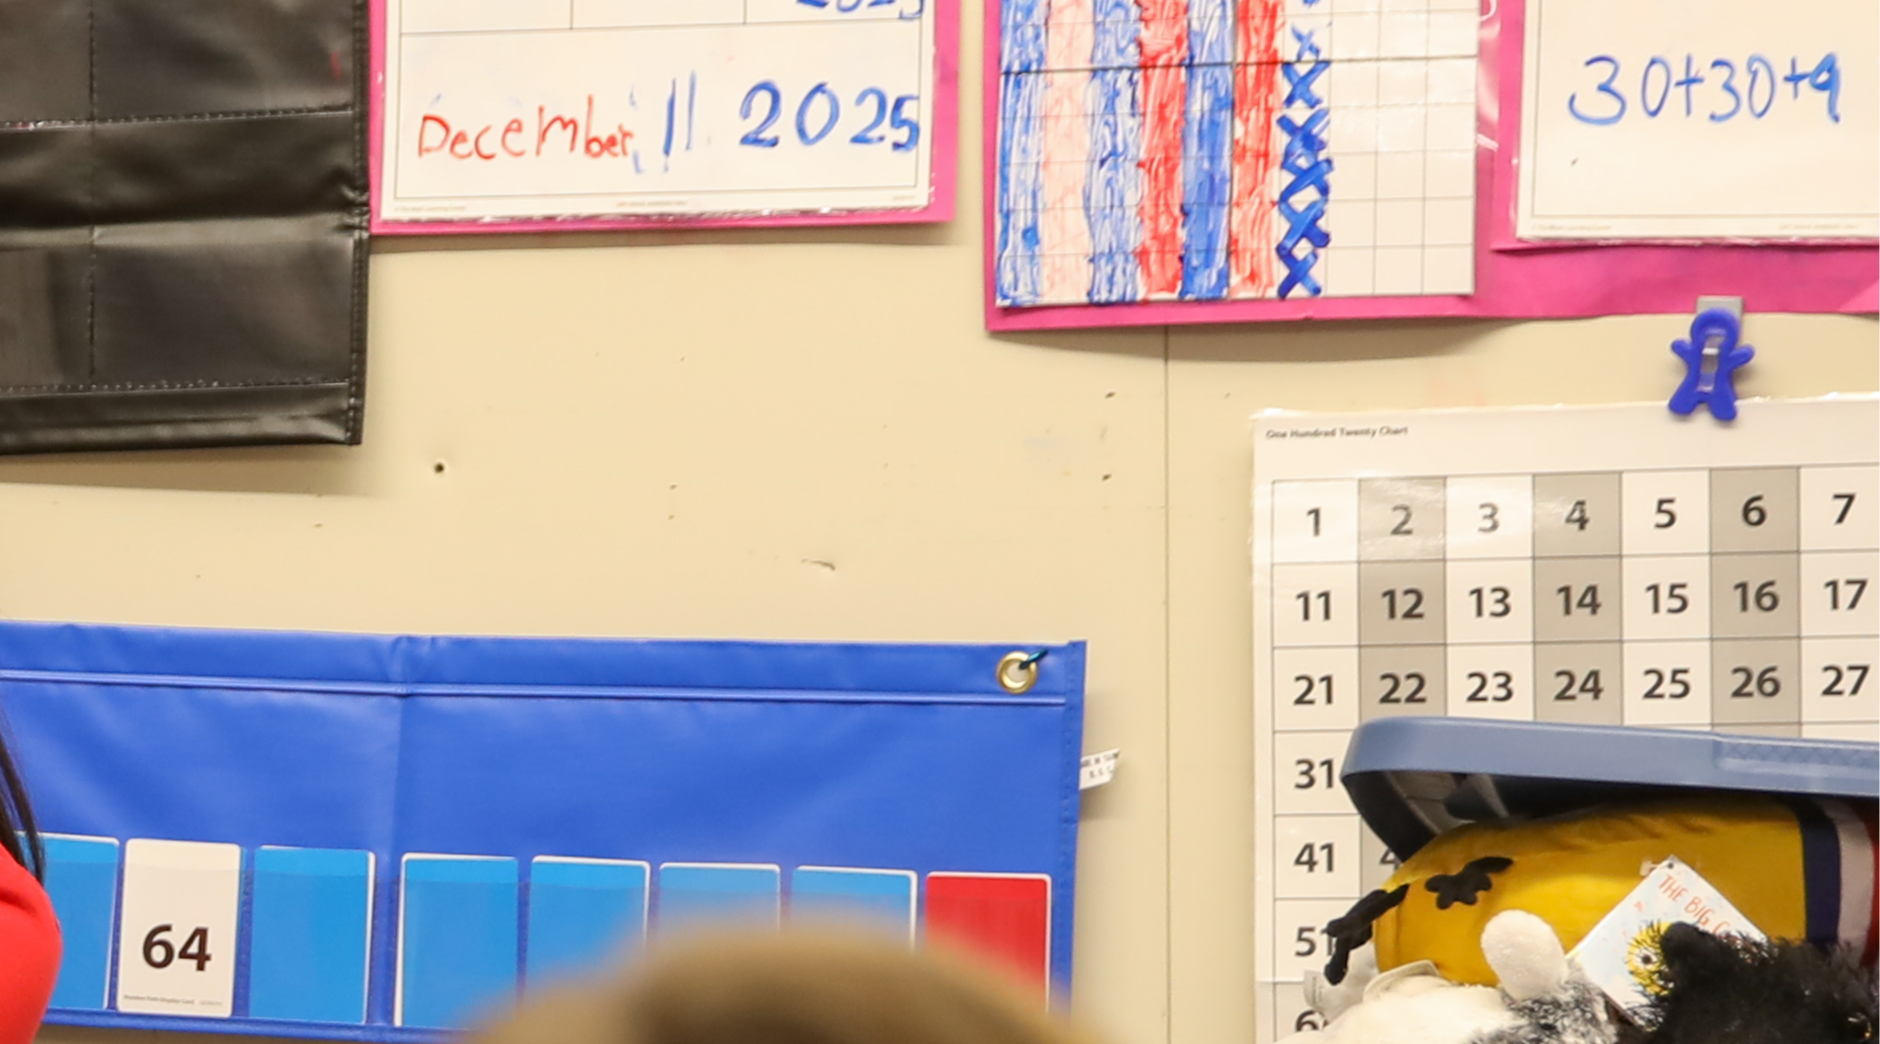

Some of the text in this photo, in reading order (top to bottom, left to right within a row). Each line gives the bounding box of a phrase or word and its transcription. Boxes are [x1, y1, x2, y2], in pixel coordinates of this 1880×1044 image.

[739, 79, 921, 153] 2025
[1306, 493, 1856, 537] 1 2 3 4 5 6 7
[1295, 578, 1869, 621] 11 12 13 14 15 16 17
[1293, 664, 1871, 705] 21 22 23 24 25 26 27
[1294, 758, 1335, 789] 31
[1293, 842, 1335, 873] 41
[1658, 874, 1716, 927] THE BIG
[143, 923, 212, 972] 64
